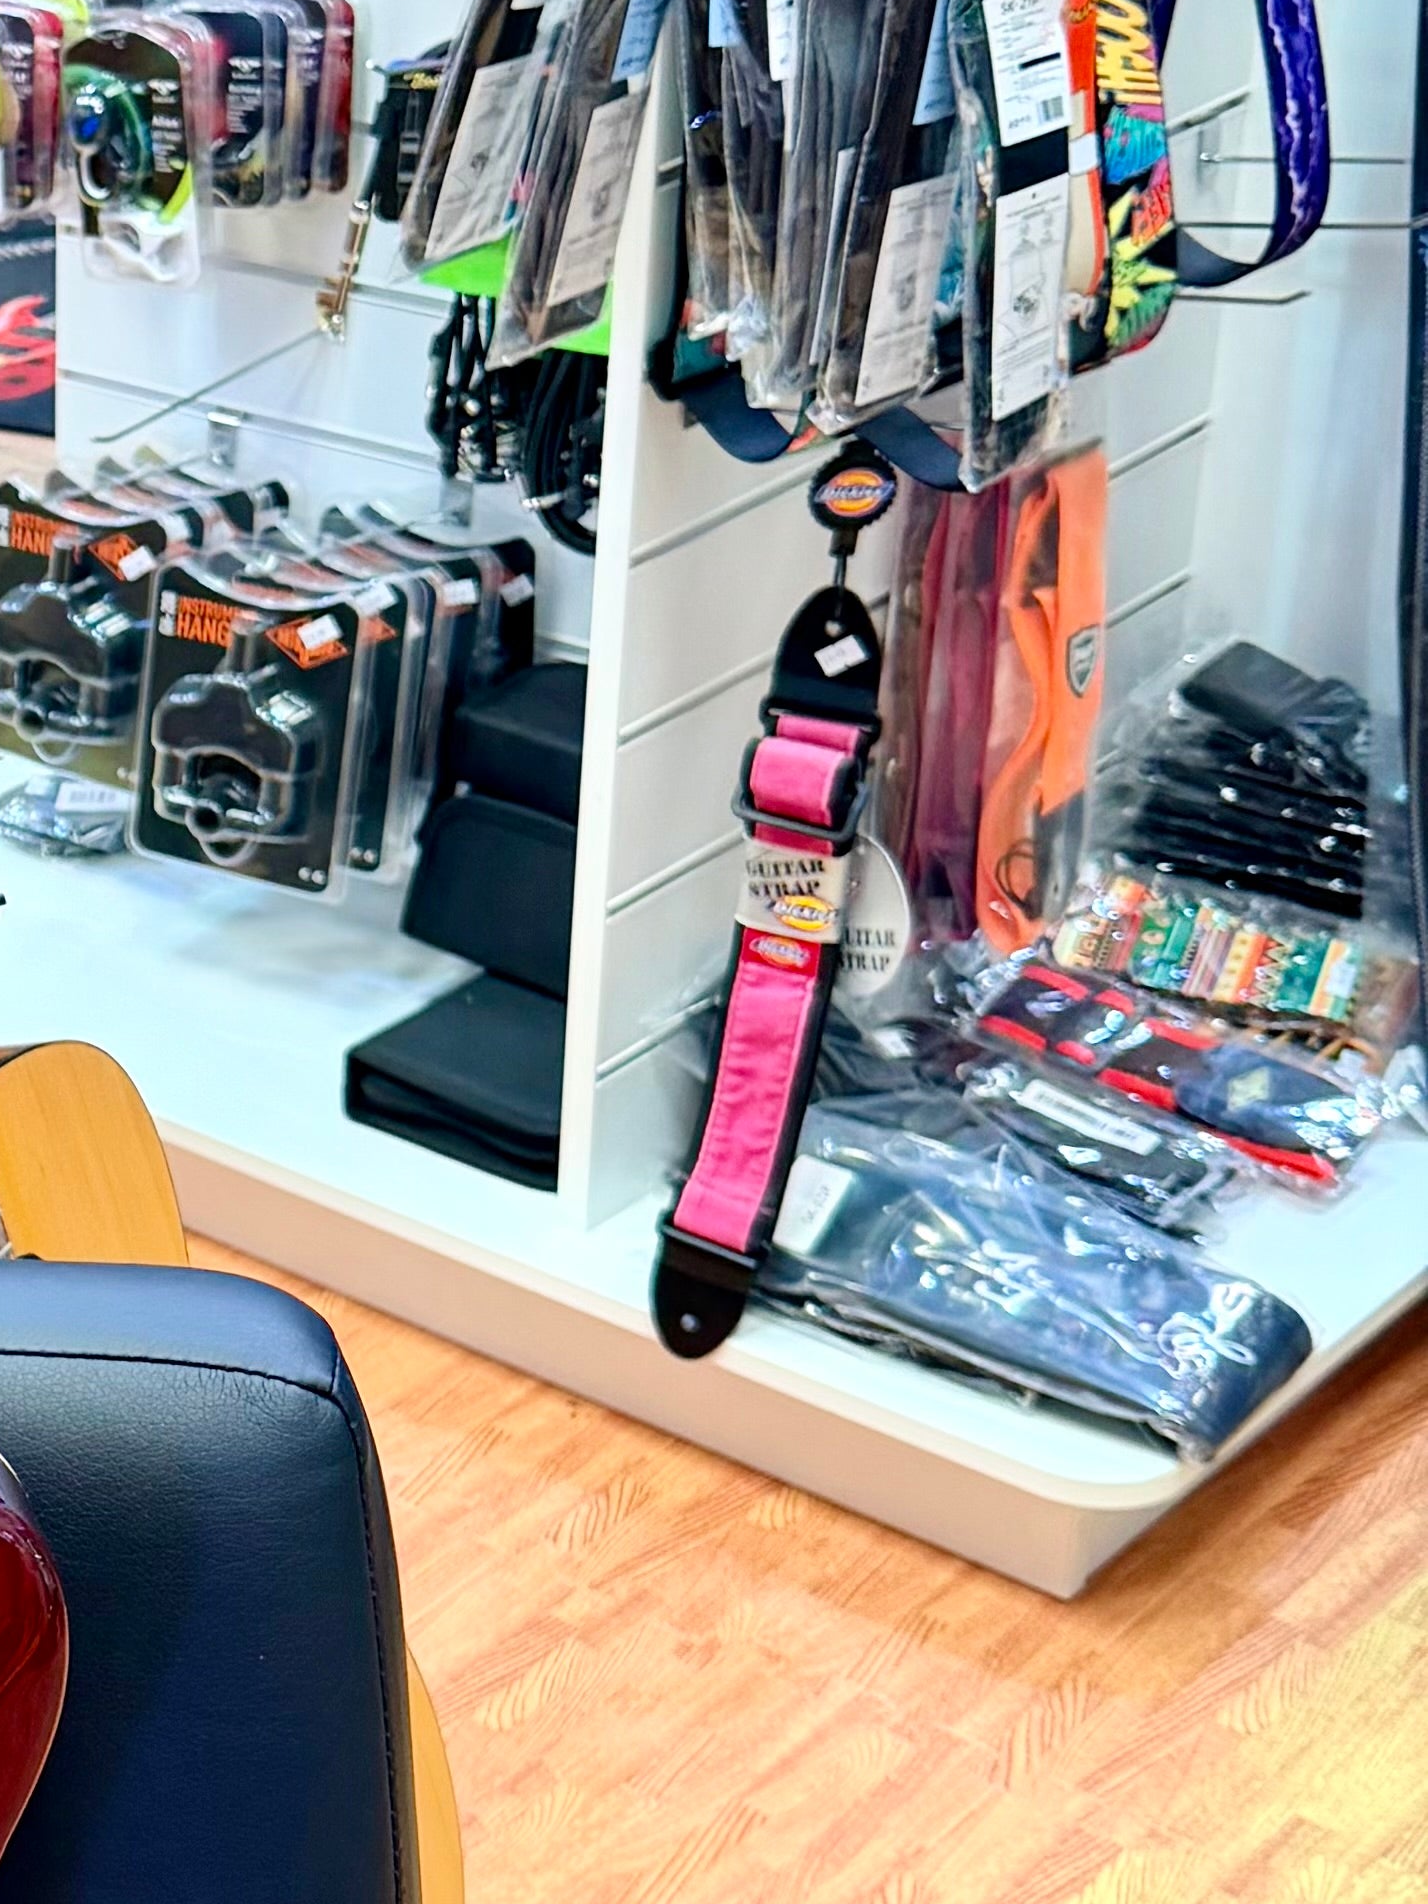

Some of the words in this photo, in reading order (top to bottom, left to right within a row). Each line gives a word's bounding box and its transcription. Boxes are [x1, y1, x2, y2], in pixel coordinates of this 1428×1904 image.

[177, 614, 232, 647] HANG
[746, 859, 825, 878] GUITAR
[748, 880, 820, 898] STRAP
[845, 927, 896, 946] UITAR
